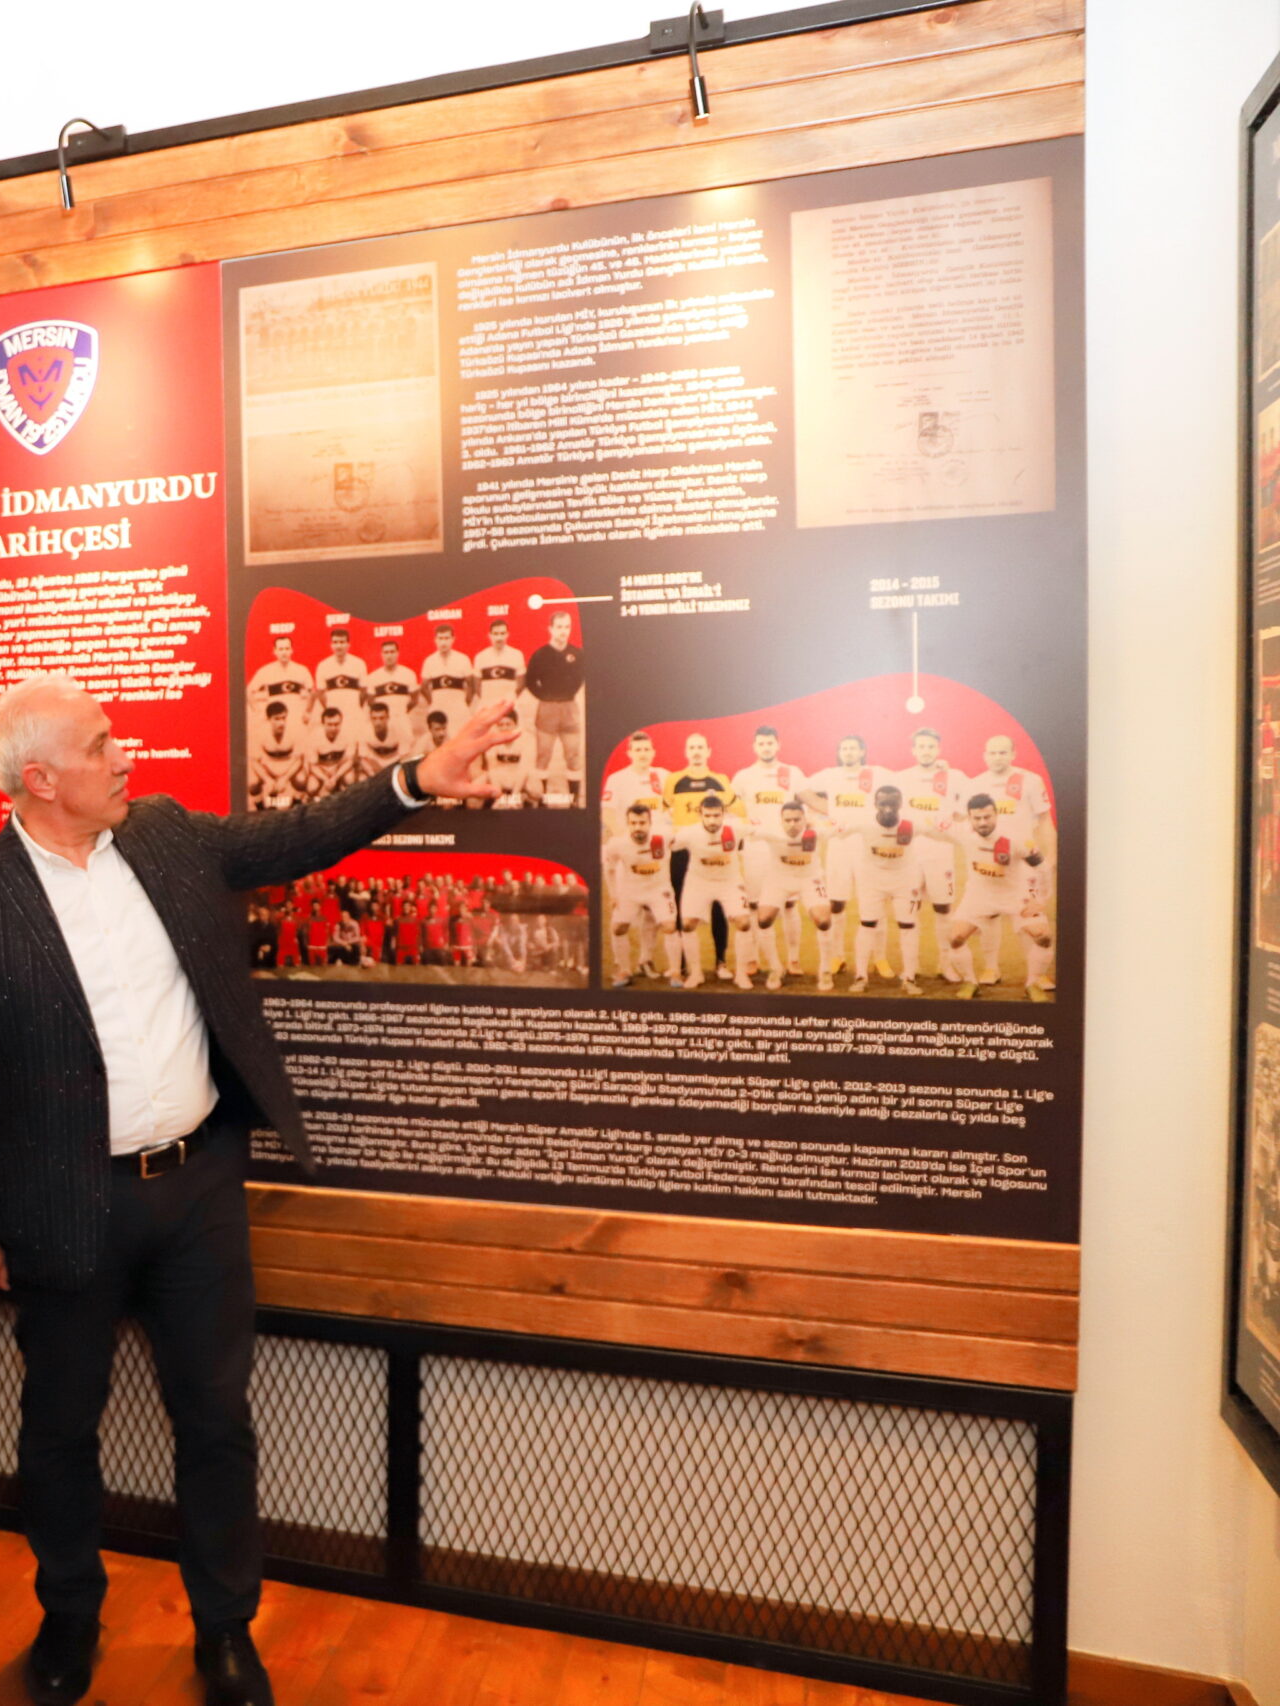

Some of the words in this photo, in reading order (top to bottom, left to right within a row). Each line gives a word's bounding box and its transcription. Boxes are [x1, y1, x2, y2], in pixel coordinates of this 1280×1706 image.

[1, 472, 218, 517] İDMANYURDU
[794, 1016, 828, 1027] Lefter
[775, 1040, 787, 1053] yıl
[790, 1042, 823, 1052] sonra
[888, 1044, 954, 1057] sezonunda
[999, 1049, 1040, 1063] düştü.
[805, 1029, 854, 1043] oynadığı
[857, 1031, 913, 1045] maçlarda
[916, 1033, 983, 1048] mağlubiyet
[987, 1036, 1052, 1051] almayarak
[766, 1052, 791, 1063] etti.
[812, 1079, 840, 1092] çıktı.
[908, 1085, 952, 1095] sezonu
[955, 1085, 1009, 1098] sonunda
[777, 1089, 812, 1101] skorla
[815, 1091, 847, 1105] yenip
[850, 1093, 878, 1104] adını
[881, 1095, 896, 1105] bir
[901, 1096, 914, 1109] yıl
[917, 1098, 952, 1108] sonra
[955, 1098, 991, 1113] Süper
[798, 1103, 855, 1118] nedeniyle
[858, 1106, 889, 1120] aldığı
[892, 1108, 947, 1121] cezalarla
[951, 1111, 965, 1125] üç
[969, 1112, 998, 1126] yılda
[1001, 1114, 1025, 1128] beş
[763, 1139, 797, 1150] sezon
[800, 1140, 850, 1153] sonunda
[853, 1143, 909, 1159] kapanma
[912, 1147, 948, 1159] kararı
[951, 1149, 999, 1165] almıştır.
[1003, 1152, 1027, 1164] Son
[795, 1152, 848, 1168] olmuştur.
[852, 1156, 896, 1168] Haziran
[948, 1161, 966, 1173] ise
[970, 1161, 994, 1177] İçel
[781, 1176, 841, 1189] tarafından
[844, 1180, 876, 1192] tescil
[941, 1186, 981, 1199] Mersin
[820, 1166, 837, 1177] ise
[840, 1167, 879, 1180] kırmızı
[882, 1170, 927, 1183] lacivert
[930, 1173, 968, 1185] olarak
[972, 1177, 986, 1187] ve
[990, 1177, 1047, 1193] logosunu
[776, 1188, 802, 1199] saklı
